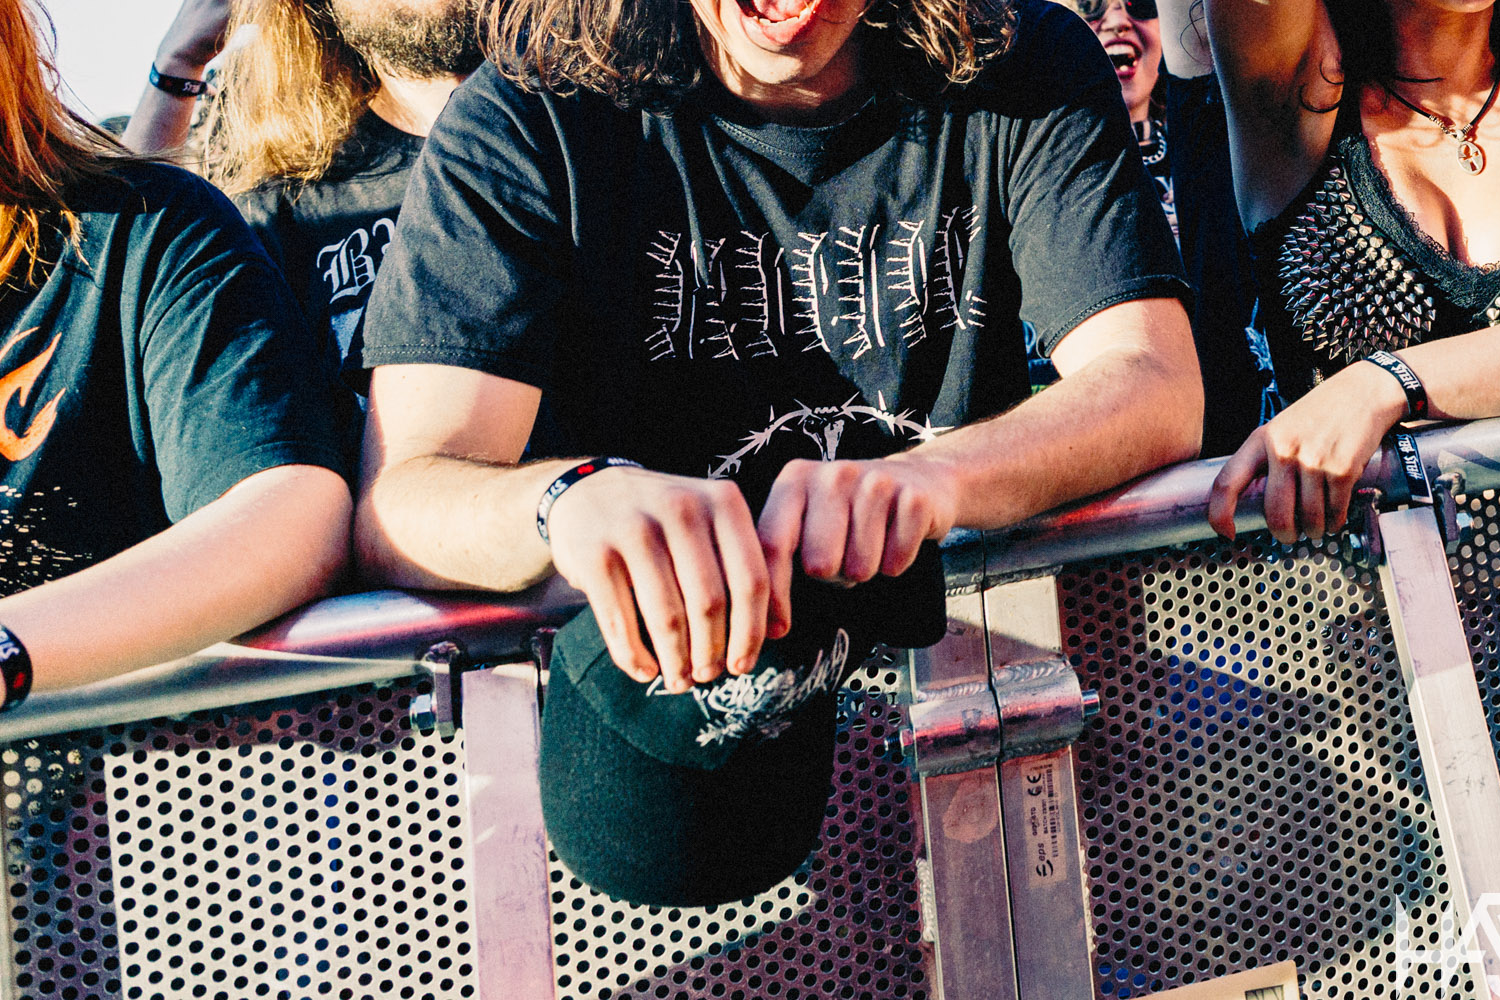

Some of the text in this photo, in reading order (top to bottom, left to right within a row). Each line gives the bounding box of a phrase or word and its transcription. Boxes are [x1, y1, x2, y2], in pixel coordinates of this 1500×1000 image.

[1391, 362, 1422, 391] HELLS
[1403, 453, 1425, 481] HELLS
[1038, 843, 1046, 862] eps
